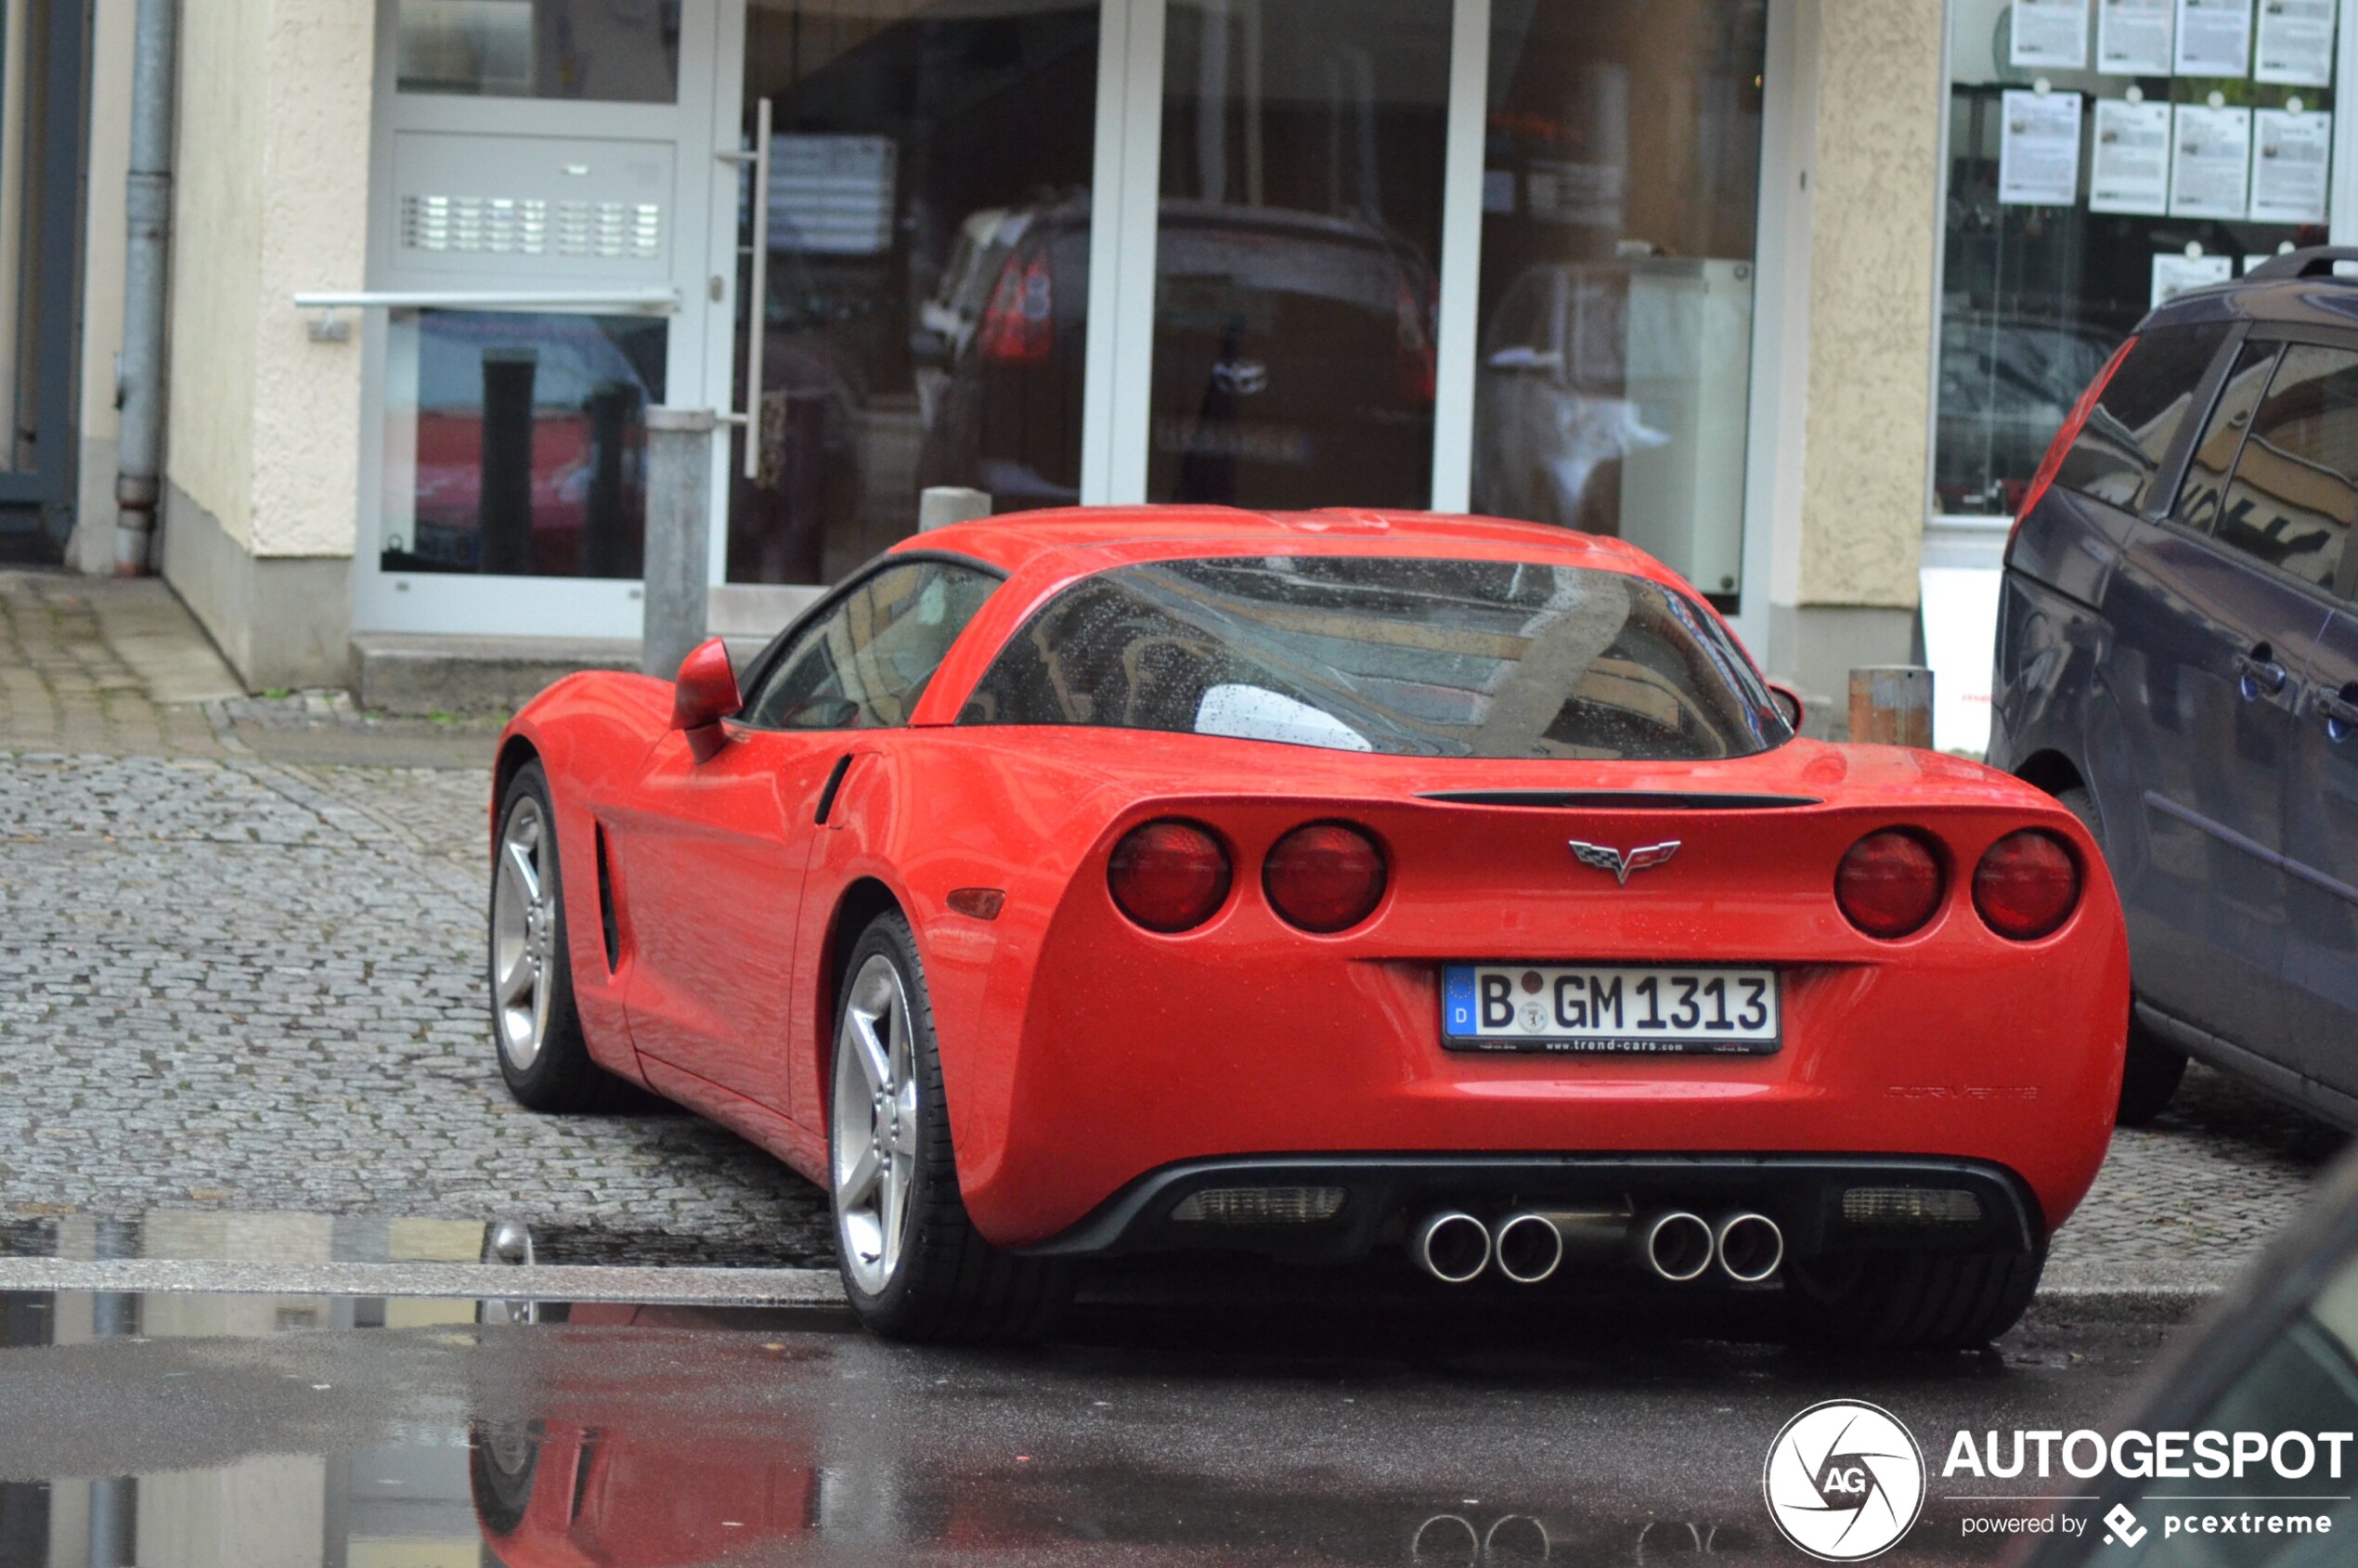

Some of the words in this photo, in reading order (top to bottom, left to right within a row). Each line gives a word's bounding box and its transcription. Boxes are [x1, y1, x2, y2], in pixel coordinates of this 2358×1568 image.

[1482, 975, 1515, 1028] B
[1554, 976, 1623, 1029] GM
[1636, 977, 1768, 1030] 1313
[1456, 1008, 1467, 1023] D
[1547, 1040, 1683, 1052] www.trend-cars.com
